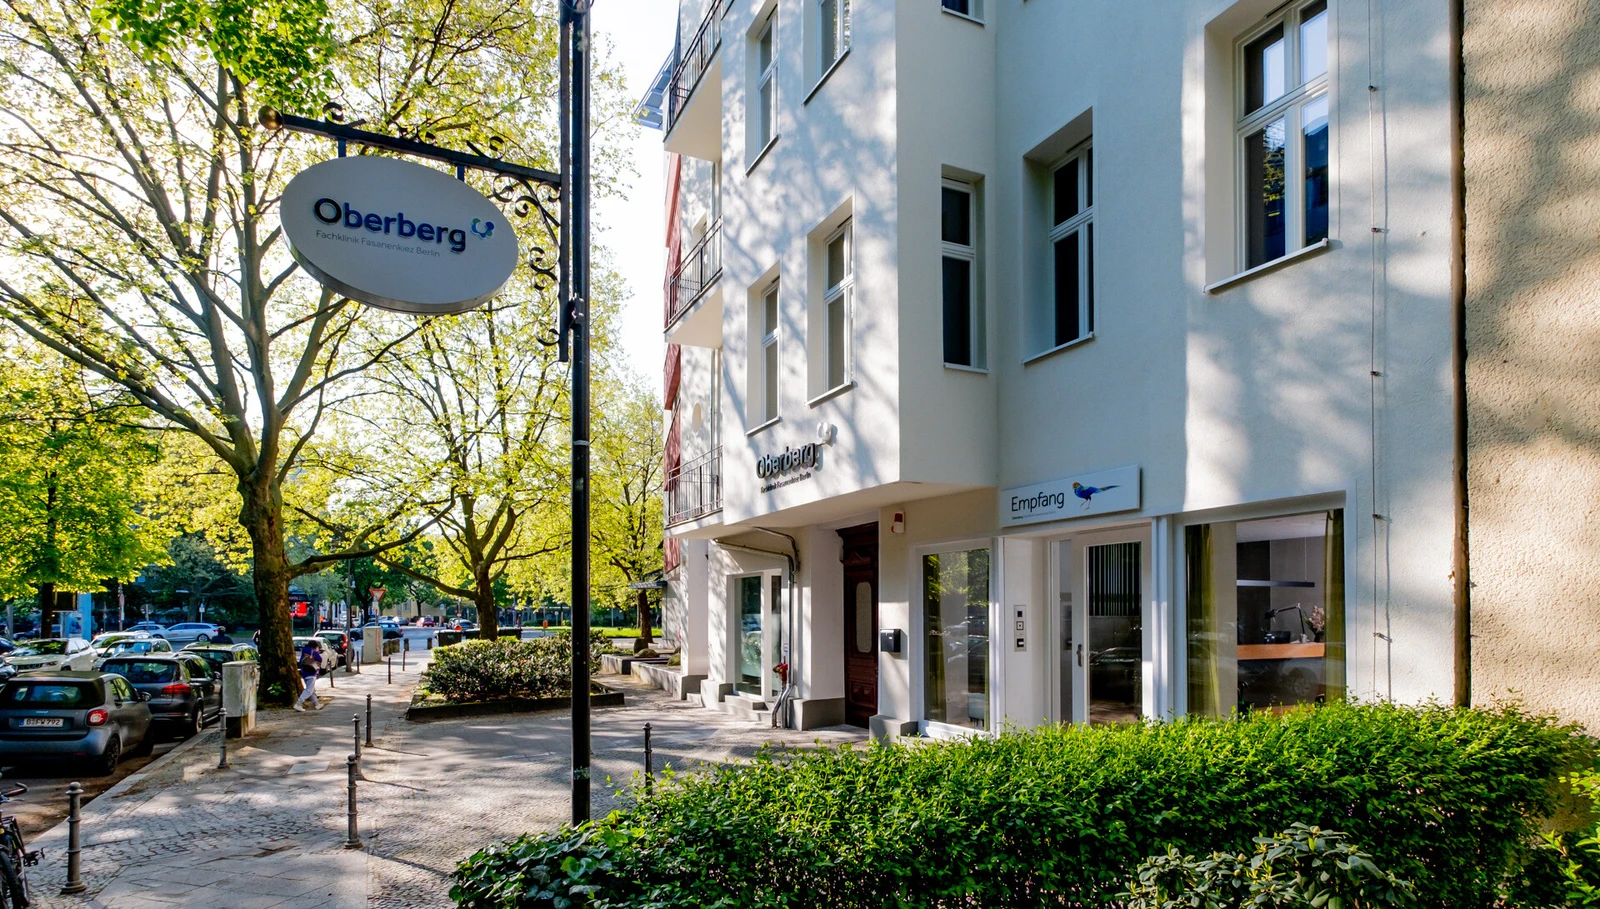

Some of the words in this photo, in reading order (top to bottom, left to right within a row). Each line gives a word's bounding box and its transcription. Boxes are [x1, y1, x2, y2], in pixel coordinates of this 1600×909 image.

[314, 197, 466, 253] Oberberg
[316, 229, 359, 245] Fachklinik
[361, 237, 414, 254] Fasanenkiez
[416, 246, 440, 258] Berlin
[757, 443, 815, 478] Oberberg
[1011, 492, 1064, 512] Empfang
